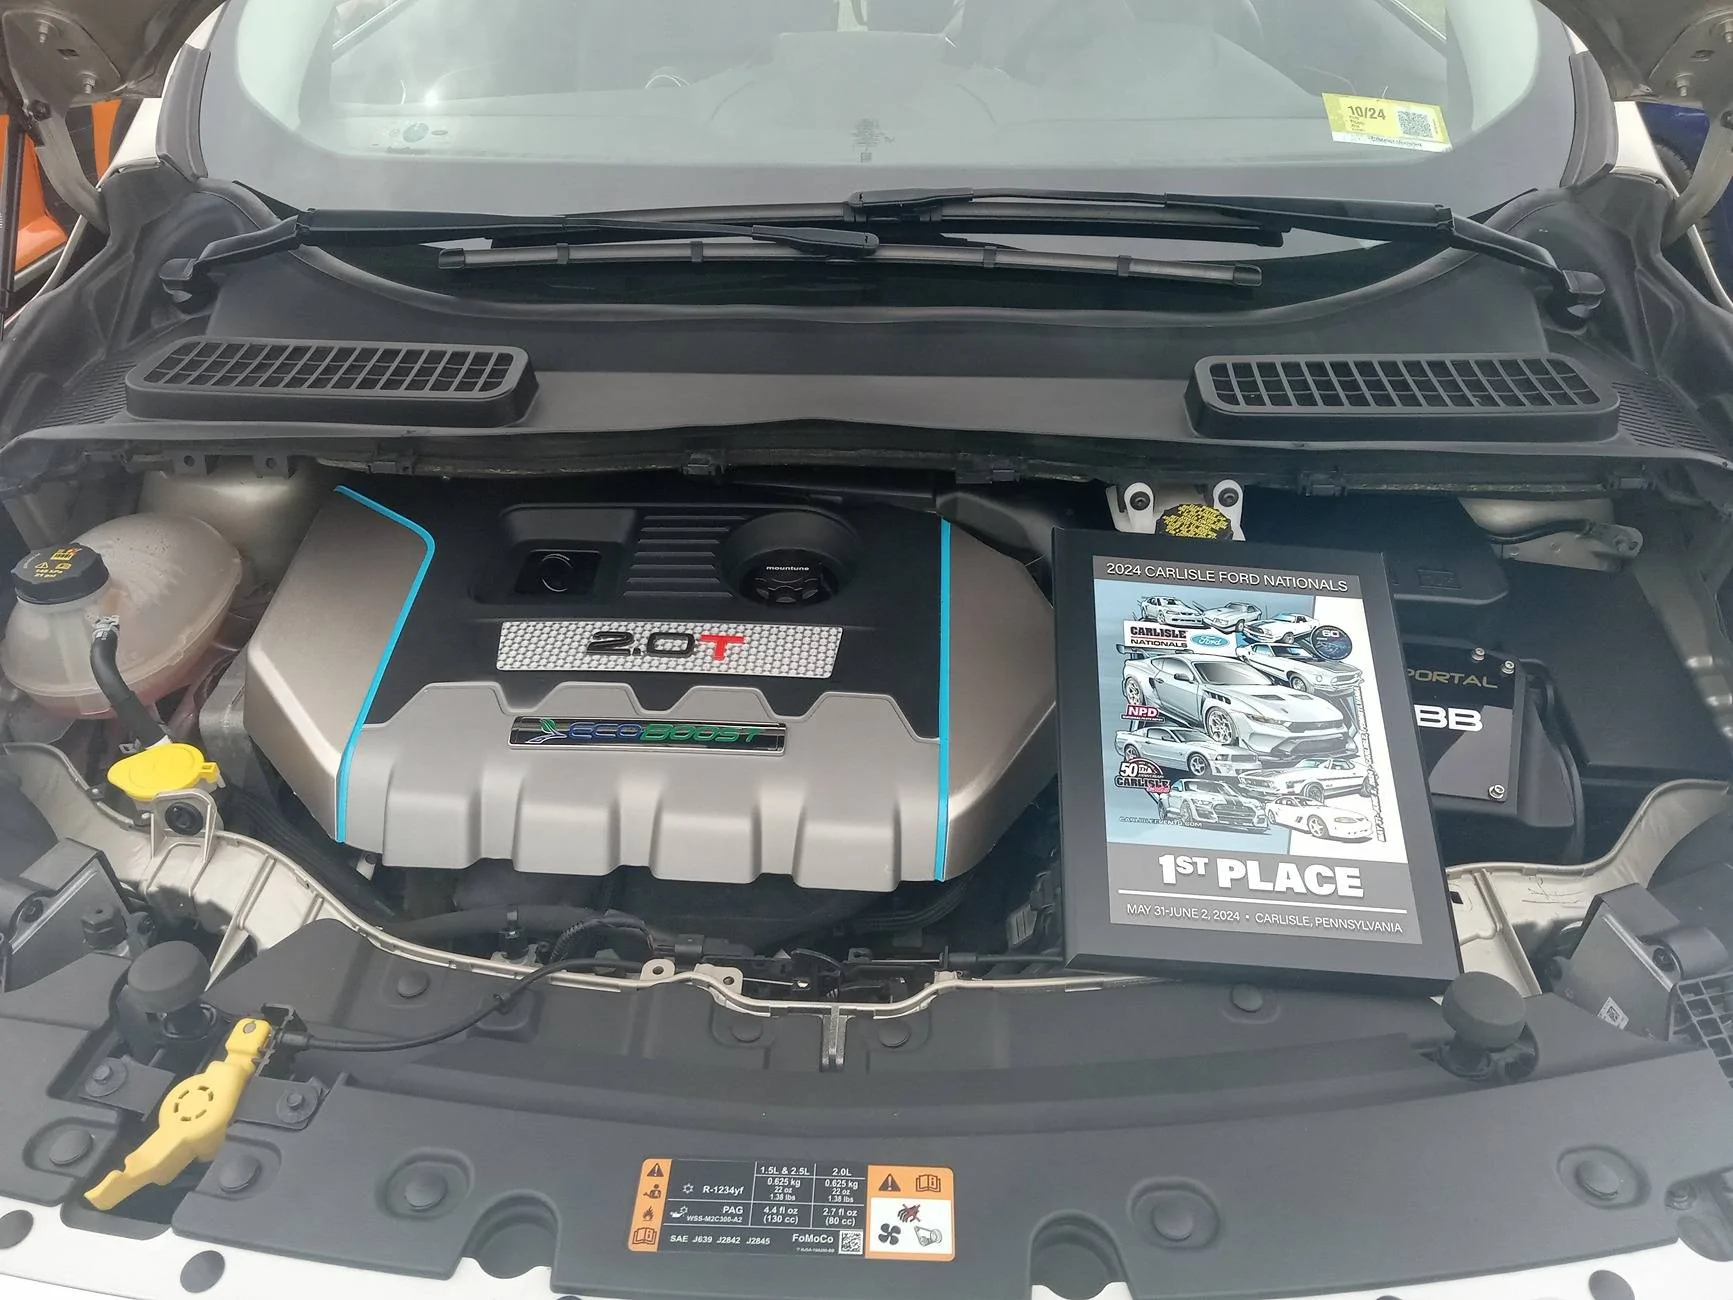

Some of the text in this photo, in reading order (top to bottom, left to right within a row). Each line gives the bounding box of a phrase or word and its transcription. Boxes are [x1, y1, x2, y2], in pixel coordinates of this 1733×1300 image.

[1348, 105, 1386, 121] 10/24
[1106, 562, 1348, 592] 2024 CARLISLE FORD NATIONALS
[1130, 626, 1187, 639] CARLISLE
[586, 631, 745, 661] 2.0T
[1130, 639, 1188, 649] NATIONALS
[1198, 636, 1222, 646] Ford
[1128, 706, 1158, 717] NPD
[568, 721, 766, 742] ECOBOOST
[1116, 777, 1169, 789] CARLISLE
[1158, 854, 1365, 898] 1ST PLACE
[1126, 903, 1403, 934] MAY 31-JUNE 2, 2024 CARLISLE, PENNSYLVANIA
[760, 1166, 810, 1176] 1.5L & 2.5L
[832, 1168, 852, 1177] 2.0L
[767, 1177, 801, 1188] 0.625 kg
[824, 1179, 859, 1190] 0.625 kg
[702, 1185, 745, 1197] R-1234yf
[722, 1205, 744, 1215] PAG
[763, 1206, 777, 1214] 4.4
[779, 1206, 786, 1214] fl
[823, 1207, 858, 1217] 2.7 fl oz
[763, 1214, 799, 1225] (130 cc)
[825, 1217, 856, 1227] (80 cc)
[669, 1235, 771, 1245] SAE J639 J2842 J2845
[792, 1233, 834, 1244] FoMoCo
